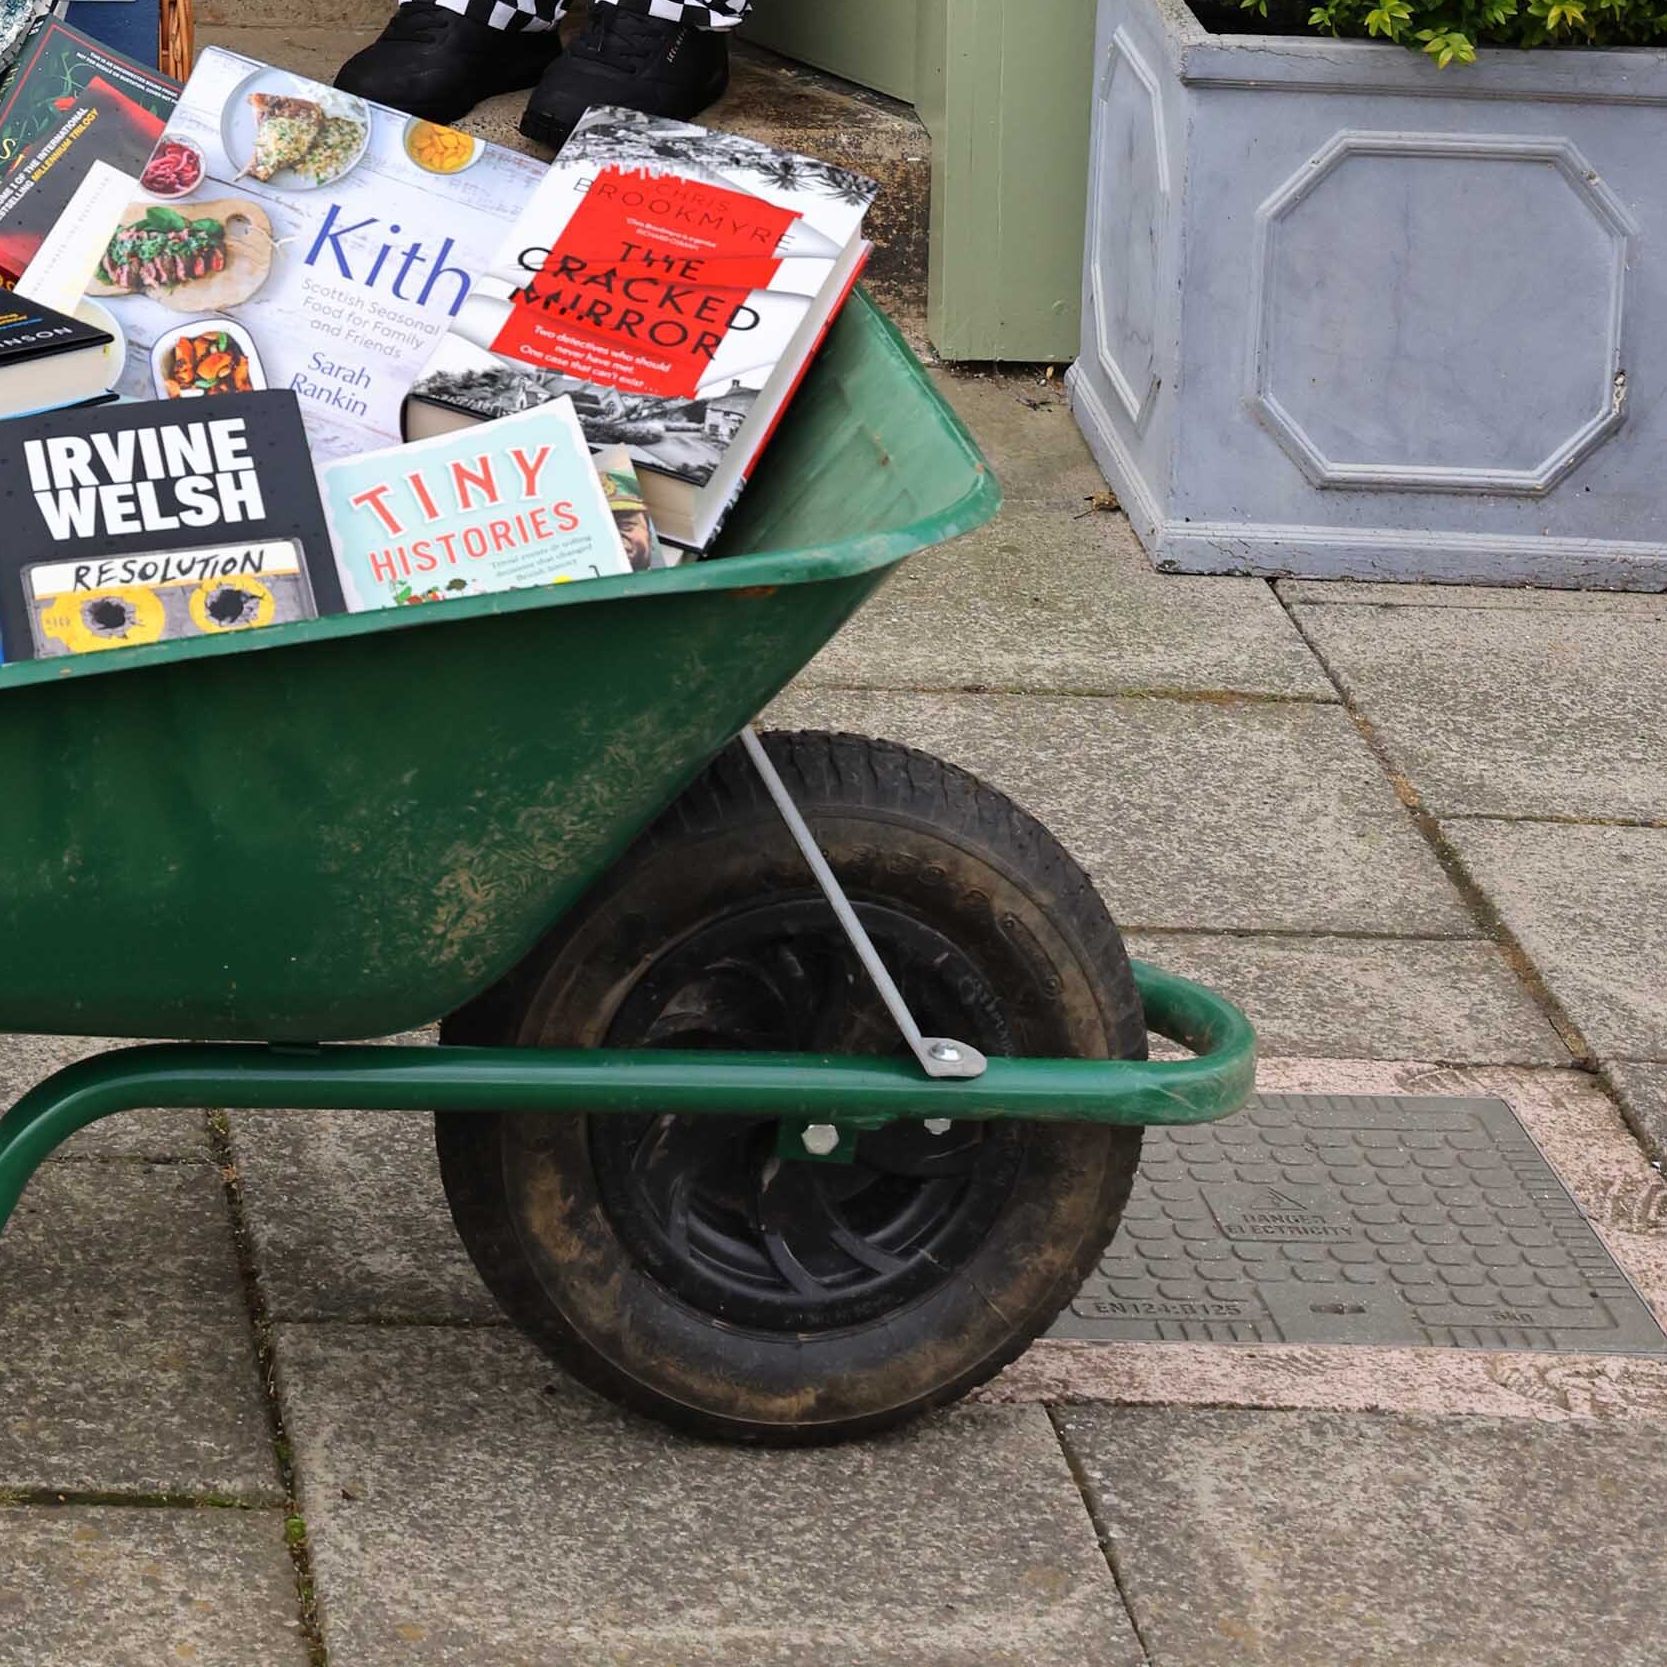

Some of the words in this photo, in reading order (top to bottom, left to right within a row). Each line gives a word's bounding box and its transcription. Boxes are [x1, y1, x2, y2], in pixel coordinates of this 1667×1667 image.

[14, 172, 27, 185] OF
[25, 158, 40, 174] THE
[36, 107, 89, 162] INTERNATIONAL
[31, 139, 73, 182] MILLENNIUM
[69, 107, 99, 139] TRILOGY
[572, 177, 797, 252] BROOKMYRE
[654, 182, 731, 213] CHRIS
[304, 203, 471, 317] Kith
[620, 241, 705, 281] THE
[301, 277, 366, 309] Scottish
[367, 301, 442, 337] Seasonal
[517, 246, 761, 331] CRACKED
[302, 295, 343, 320] Food
[346, 311, 370, 329] for
[371, 321, 425, 350] Family
[309, 318, 342, 337] and
[344, 329, 402, 359] Friends
[507, 282, 722, 361] MIRROR
[534, 324, 556, 339] Two
[556, 332, 609, 355] detectives
[610, 350, 633, 361] who
[635, 356, 672, 373] should
[307, 351, 372, 390] Sarah
[519, 344, 544, 359] One
[544, 353, 569, 366] case
[570, 359, 592, 372] that
[592, 368, 618, 380] can't
[555, 345, 585, 360] never
[585, 353, 611, 367] have
[612, 361, 634, 373] met.
[289, 372, 369, 417] Rankin
[23, 418, 254, 492] IRVINE
[34, 470, 266, 541] WELSH
[351, 445, 551, 535] TINY
[368, 501, 580, 583] HISTORIES
[74, 550, 265, 592] RESOLUTION
[1225, 1225, 1352, 1235] ELECTRICITY
[1242, 1214, 1326, 1223] DANGER
